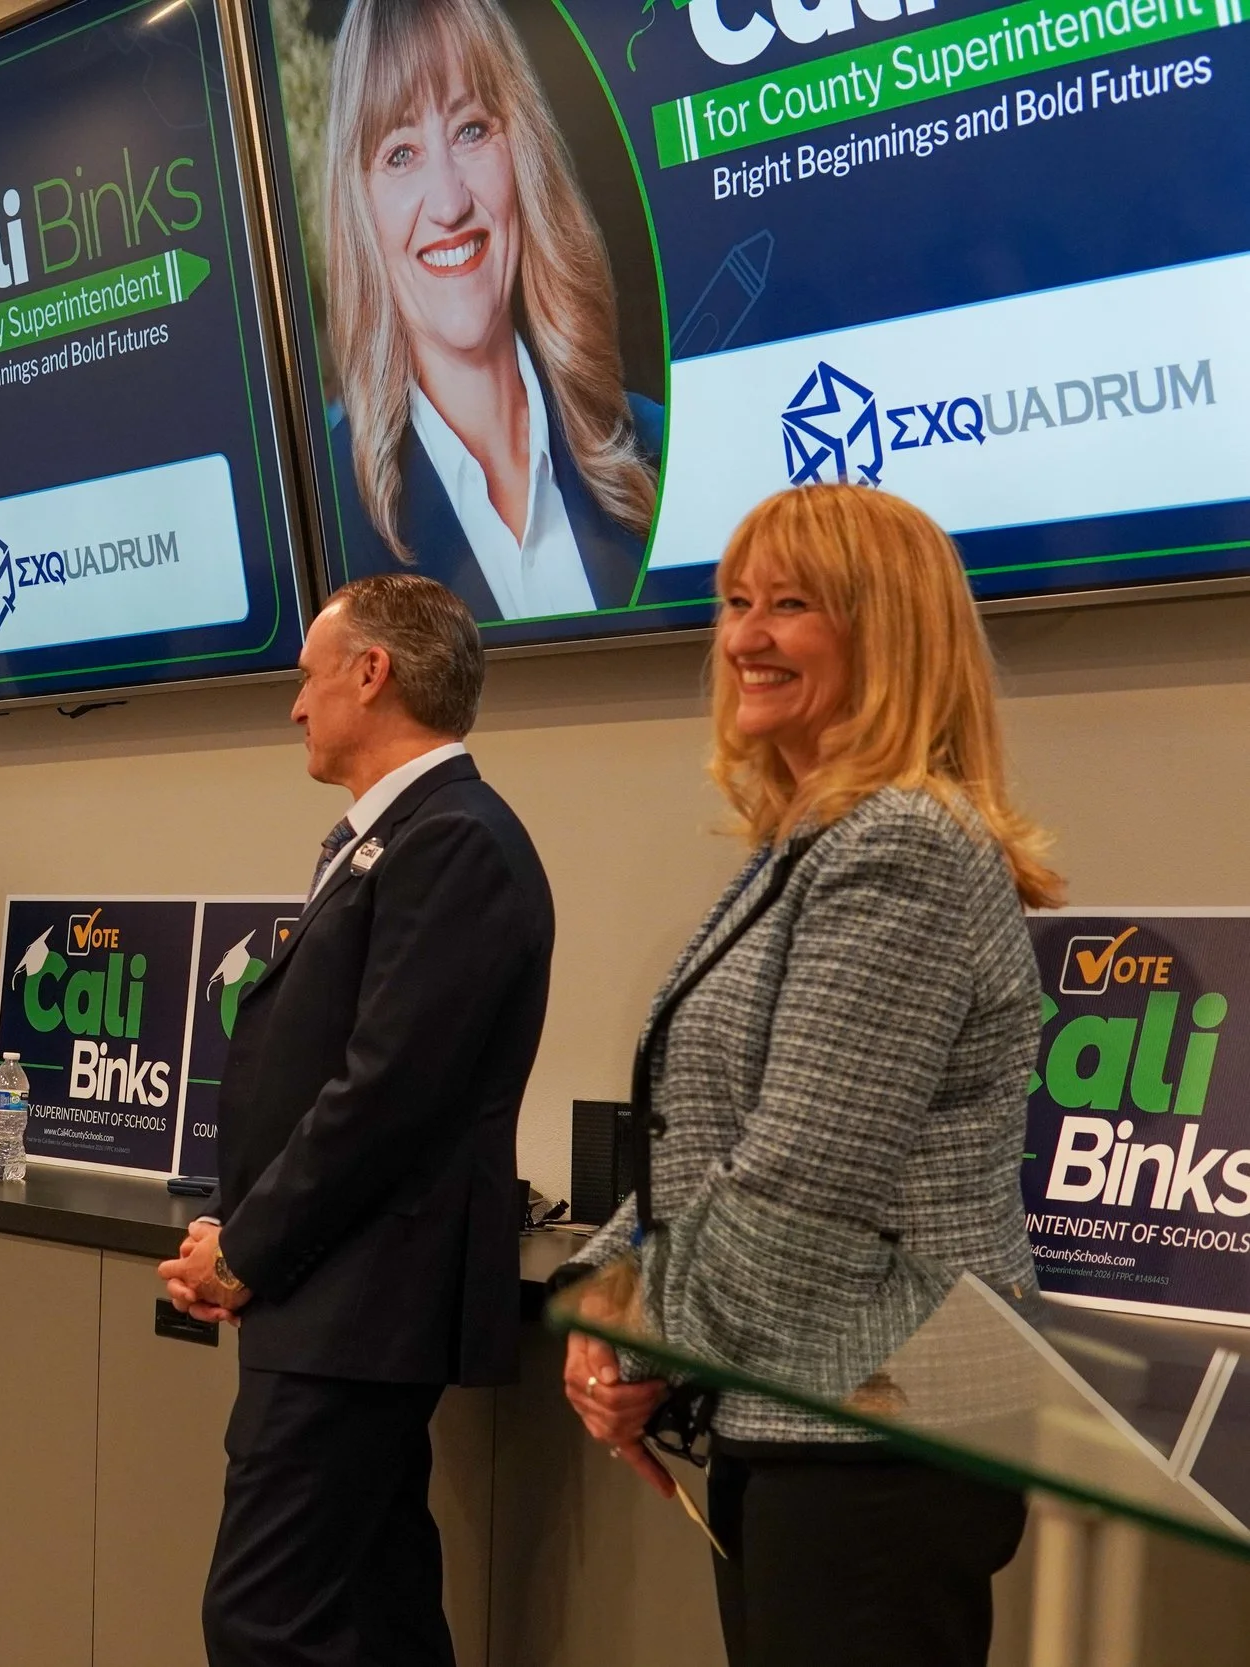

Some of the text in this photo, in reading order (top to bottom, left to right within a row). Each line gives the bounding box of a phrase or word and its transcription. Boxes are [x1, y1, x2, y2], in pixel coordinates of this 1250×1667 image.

[703, 99, 750, 141] for
[759, 61, 883, 125] County
[713, 55, 1212, 200] Bright Beginnings and Bold Futures
[33, 147, 203, 274] Binks
[8, 265, 163, 338] Superintendent
[41, 344, 68, 375] and
[71, 334, 105, 367] Bold
[108, 323, 169, 357] Futures
[73, 908, 120, 949] VOTE
[1076, 926, 1173, 985] VOTE
[23, 951, 147, 1039] Cali
[69, 1040, 170, 1108] Binks
[1027, 991, 1228, 1116] ali
[35, 1104, 111, 1125] SUPERINTENDENT
[111, 1112, 124, 1127] OF
[124, 1114, 167, 1131] SCHOOLS
[1045, 1116, 1250, 1217] Binks
[1025, 1213, 1250, 1253] INTENDENT OF SCHOOLS
[1029, 1244, 1136, 1267] i4CountySchools.com
[1094, 1269, 1111, 1279] 2026
[1115, 1271, 1134, 1282] FPPC
